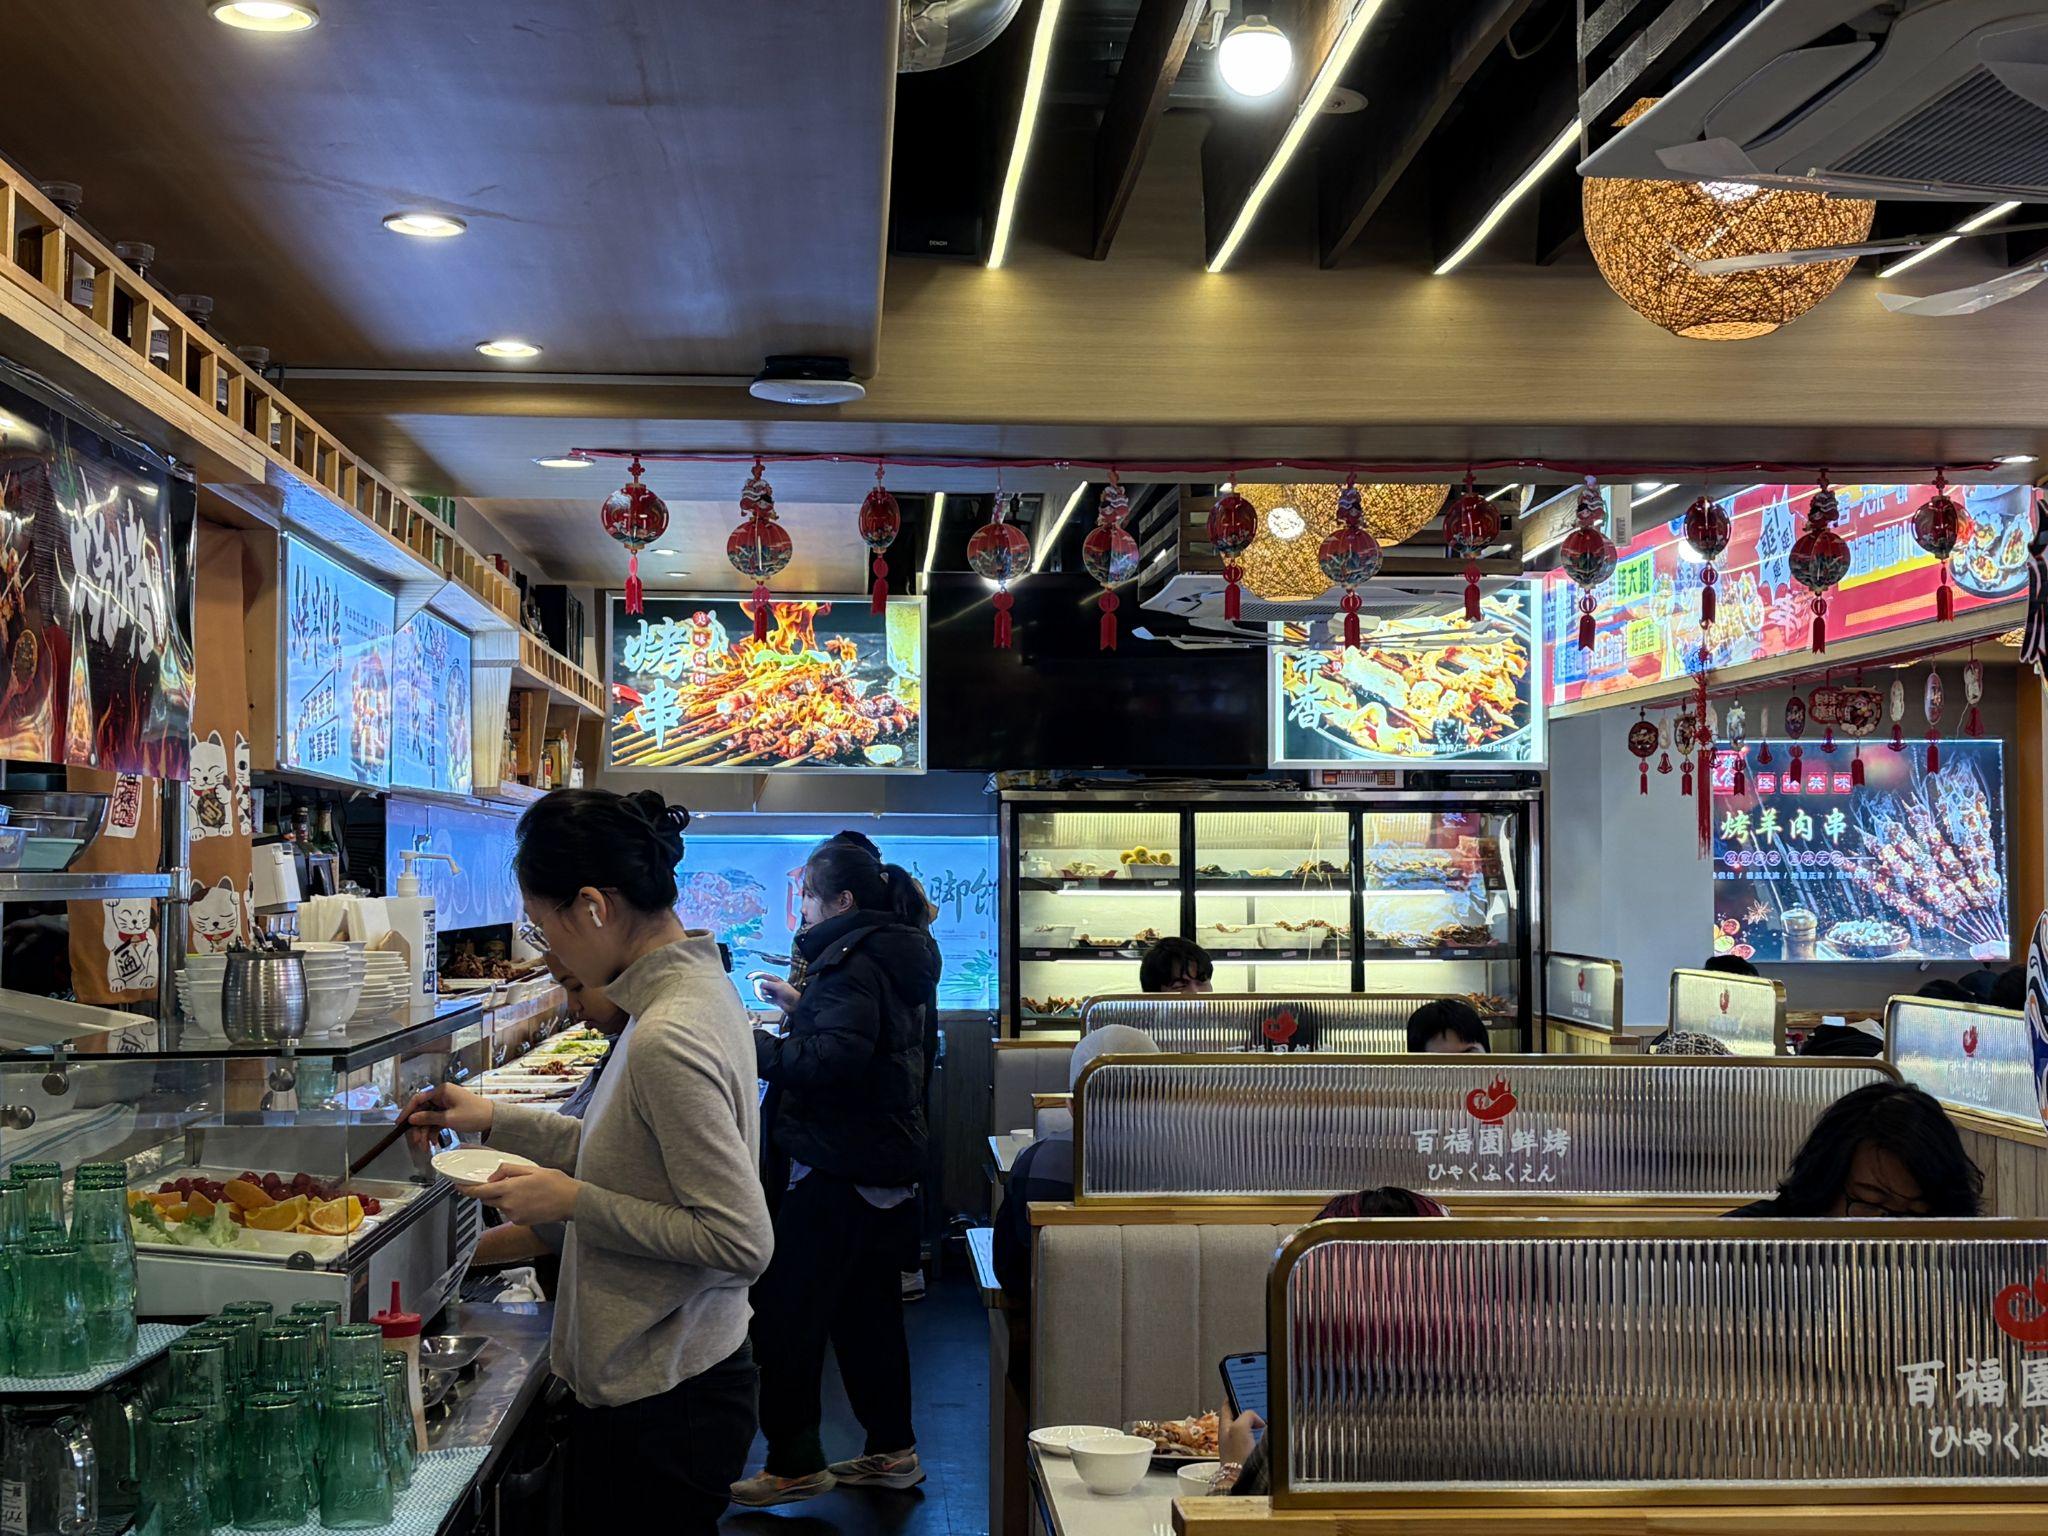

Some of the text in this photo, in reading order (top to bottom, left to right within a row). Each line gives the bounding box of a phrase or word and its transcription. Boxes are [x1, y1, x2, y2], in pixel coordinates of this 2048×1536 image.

[624, 616, 689, 750] 烤串
[1721, 807, 1847, 845] 烤羊肉串
